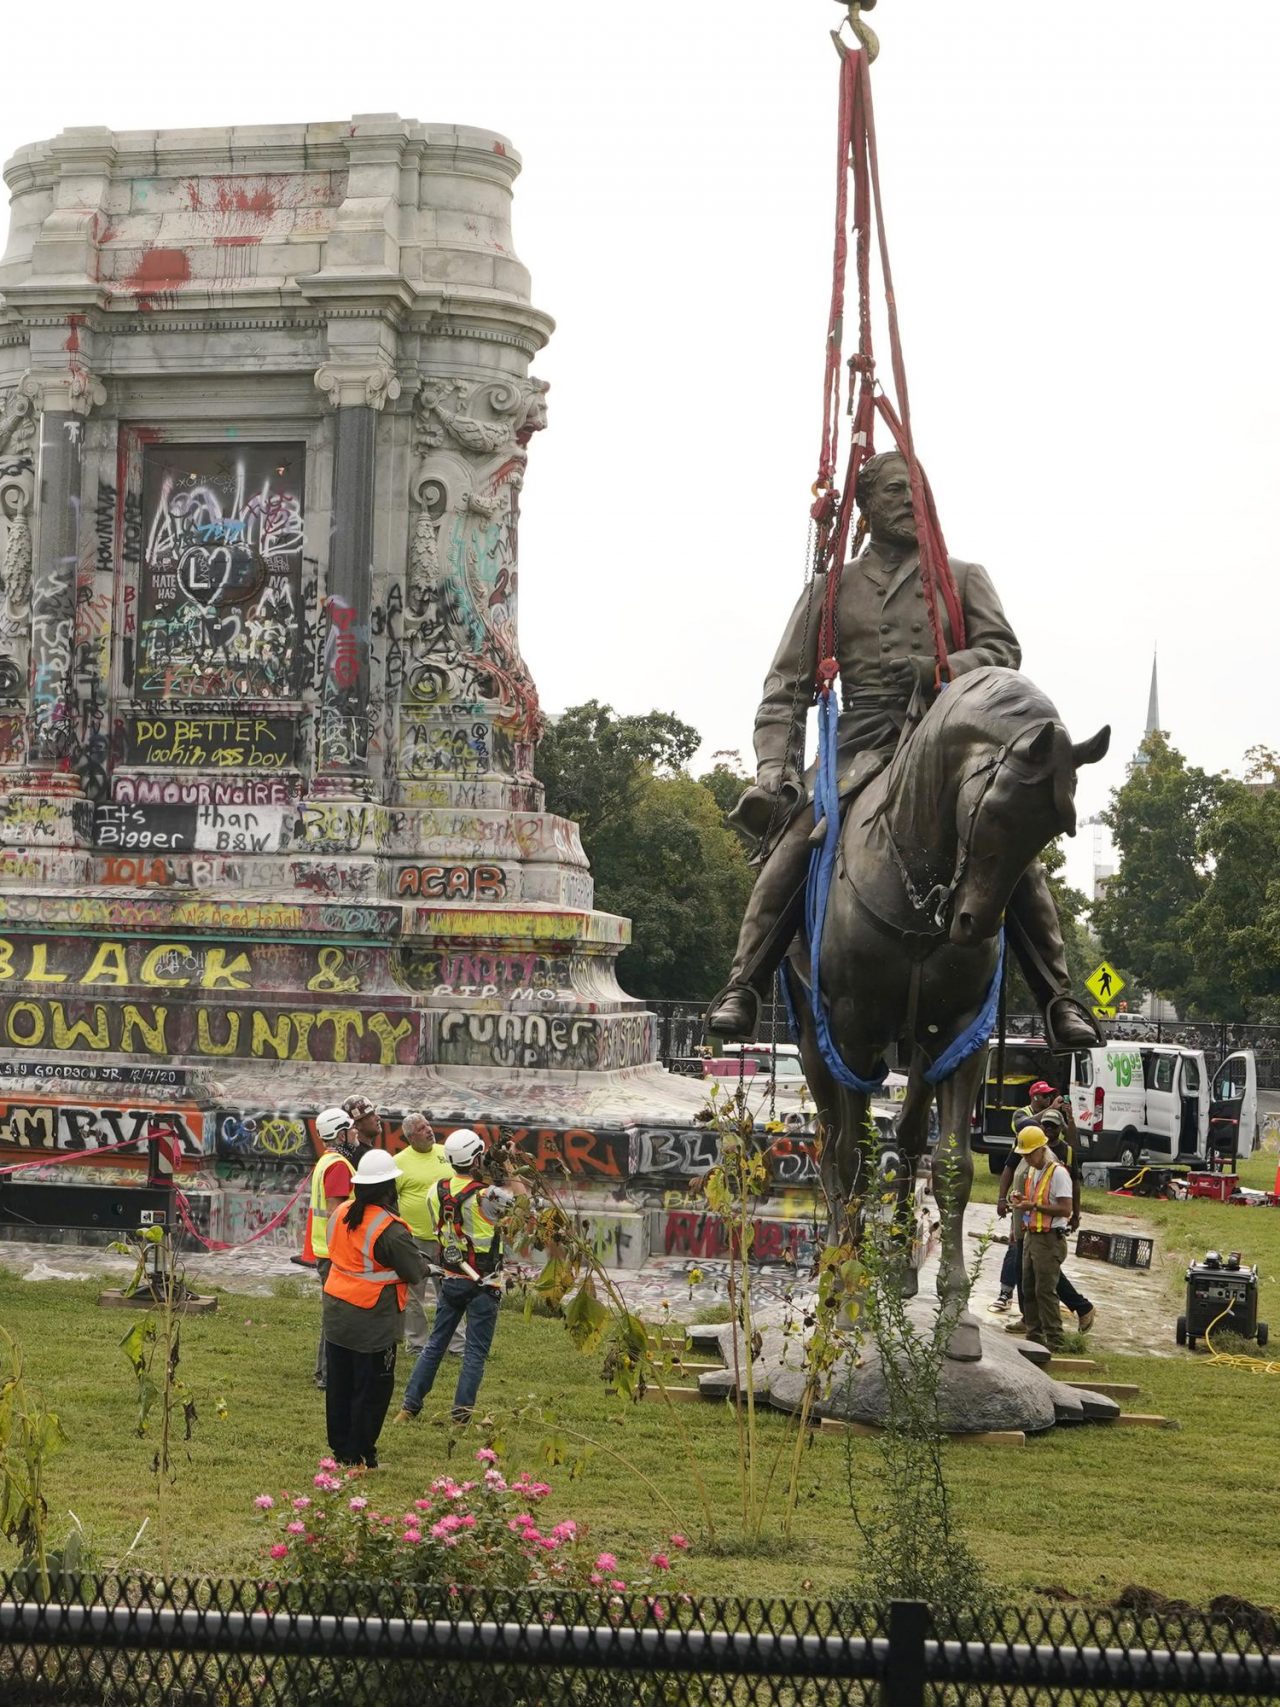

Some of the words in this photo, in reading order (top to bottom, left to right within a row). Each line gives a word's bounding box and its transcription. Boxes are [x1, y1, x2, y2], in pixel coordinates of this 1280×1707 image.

[152, 575, 176, 588] HATE
[158, 588, 177, 600] HAS
[136, 720, 167, 746] DO
[174, 720, 276, 743] BETTER
[248, 744, 288, 769] boy
[96, 803, 147, 824] It's
[198, 804, 260, 829] than
[96, 826, 185, 849] Bigger
[215, 831, 272, 851] B&W
[396, 865, 507, 899] ACAB
[307, 947, 361, 993] &
[439, 953, 538, 986] UNITY
[197, 1006, 413, 1066] UNITY
[442, 1012, 594, 1050] runner
